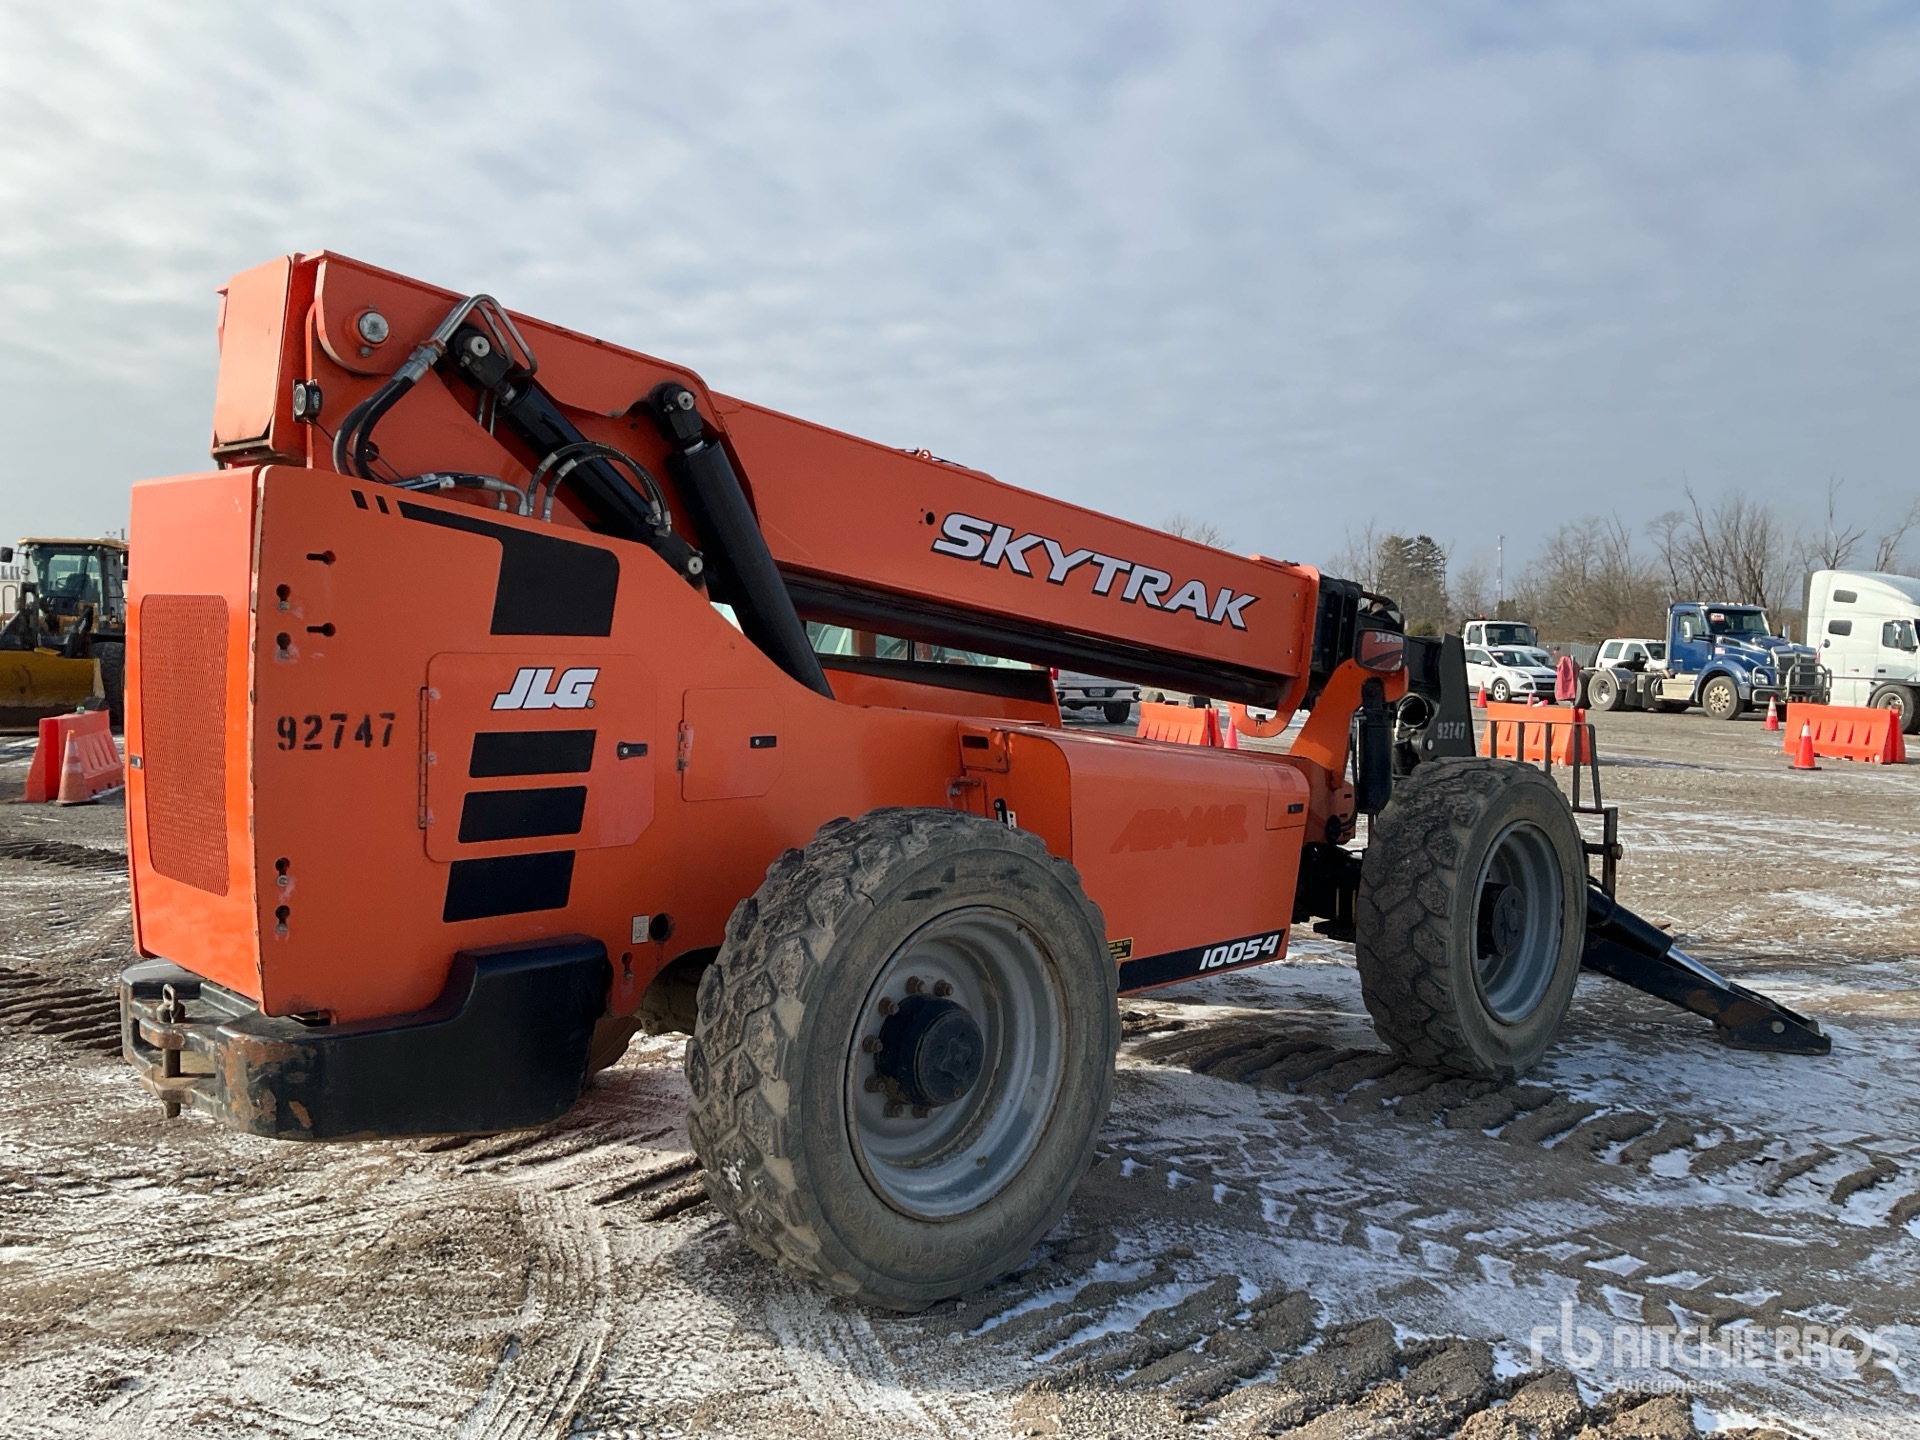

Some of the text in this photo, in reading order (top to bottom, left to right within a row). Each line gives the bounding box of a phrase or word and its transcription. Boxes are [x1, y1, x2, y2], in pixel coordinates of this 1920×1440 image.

[930, 512, 1262, 631] SKYTRAK
[277, 713, 396, 750] 92747
[1437, 721, 1466, 739] 92747
[1199, 934, 1279, 970] 10054
